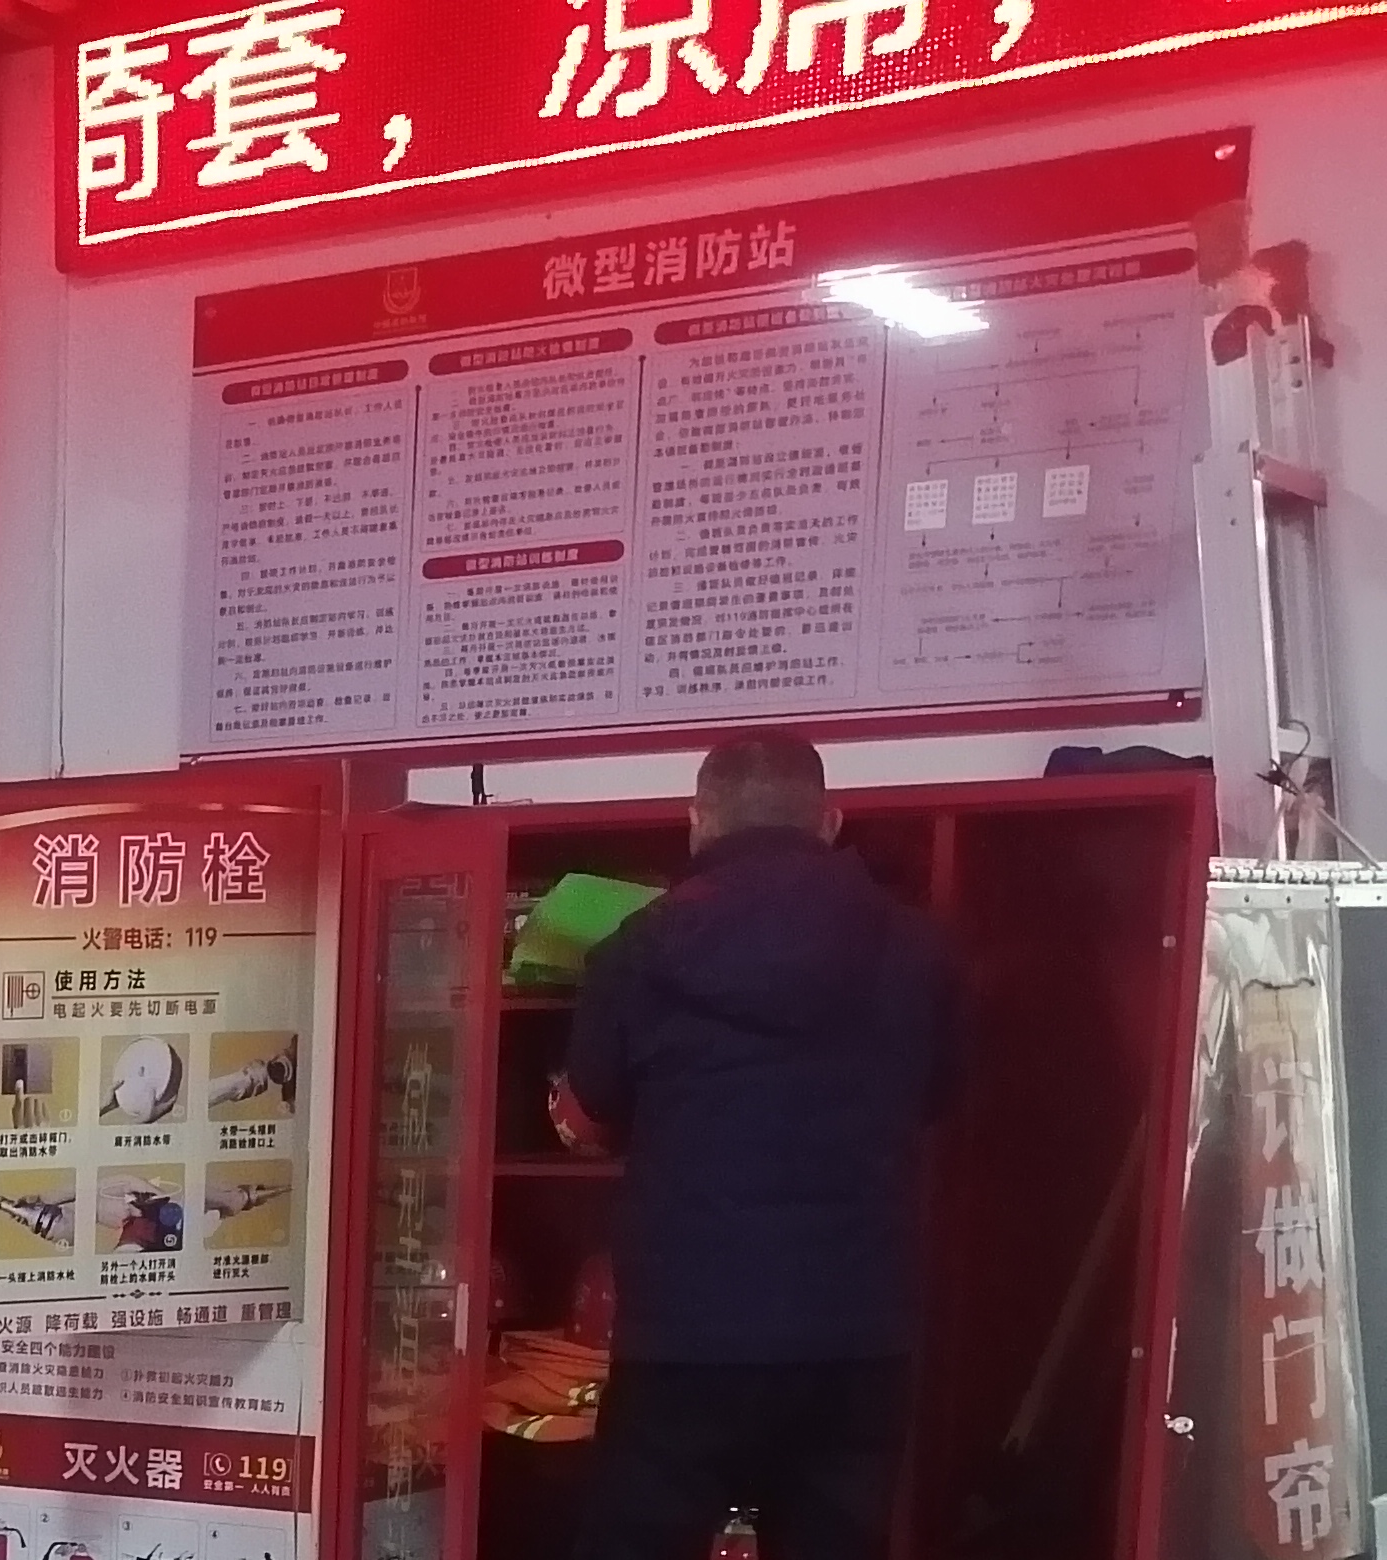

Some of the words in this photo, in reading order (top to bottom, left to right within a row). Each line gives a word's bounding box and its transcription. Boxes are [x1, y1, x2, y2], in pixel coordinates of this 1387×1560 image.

[542, 220, 797, 301] 微型消防站
[32, 830, 271, 909] 消防栓
[82, 926, 218, 951] 火警电话：119
[53, 968, 146, 992] 使用方法
[52, 998, 218, 1020] 电起火要先切断电源
[45, 1311, 98, 1333] 降荷载
[111, 1308, 164, 1329] 强设施
[177, 1304, 228, 1325] 畅通道
[240, 1301, 292, 1323] 重管理
[1255, 1057, 1335, 1551] 订做门帘
[62, 1441, 183, 1491] 灭火器
[238, 1454, 287, 1482] 119
